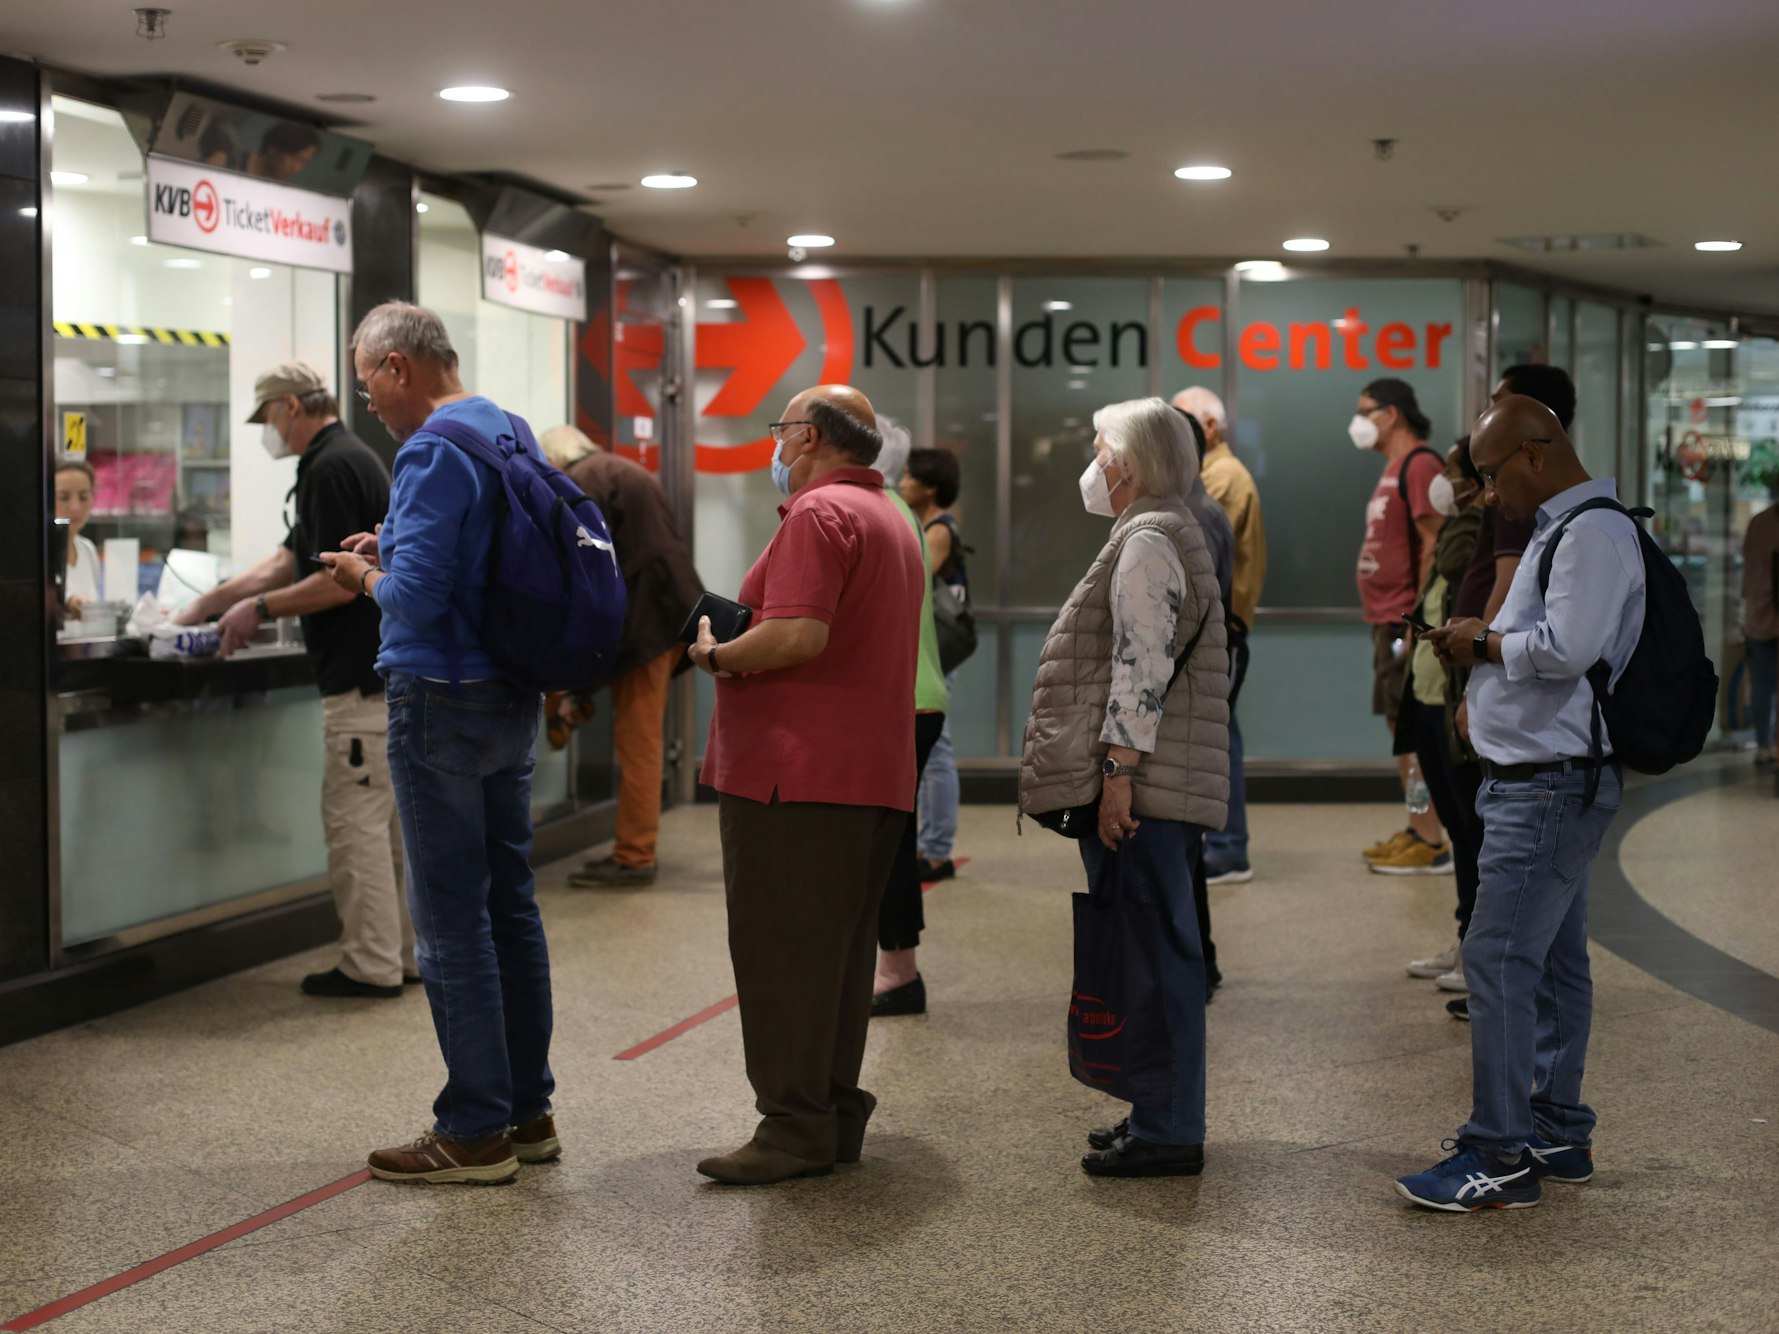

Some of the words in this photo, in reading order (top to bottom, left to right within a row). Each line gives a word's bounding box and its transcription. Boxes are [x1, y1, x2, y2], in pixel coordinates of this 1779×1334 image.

[155, 183, 191, 217] KVB
[863, 305, 1148, 368] Kunden
[1175, 305, 1453, 371] Center
